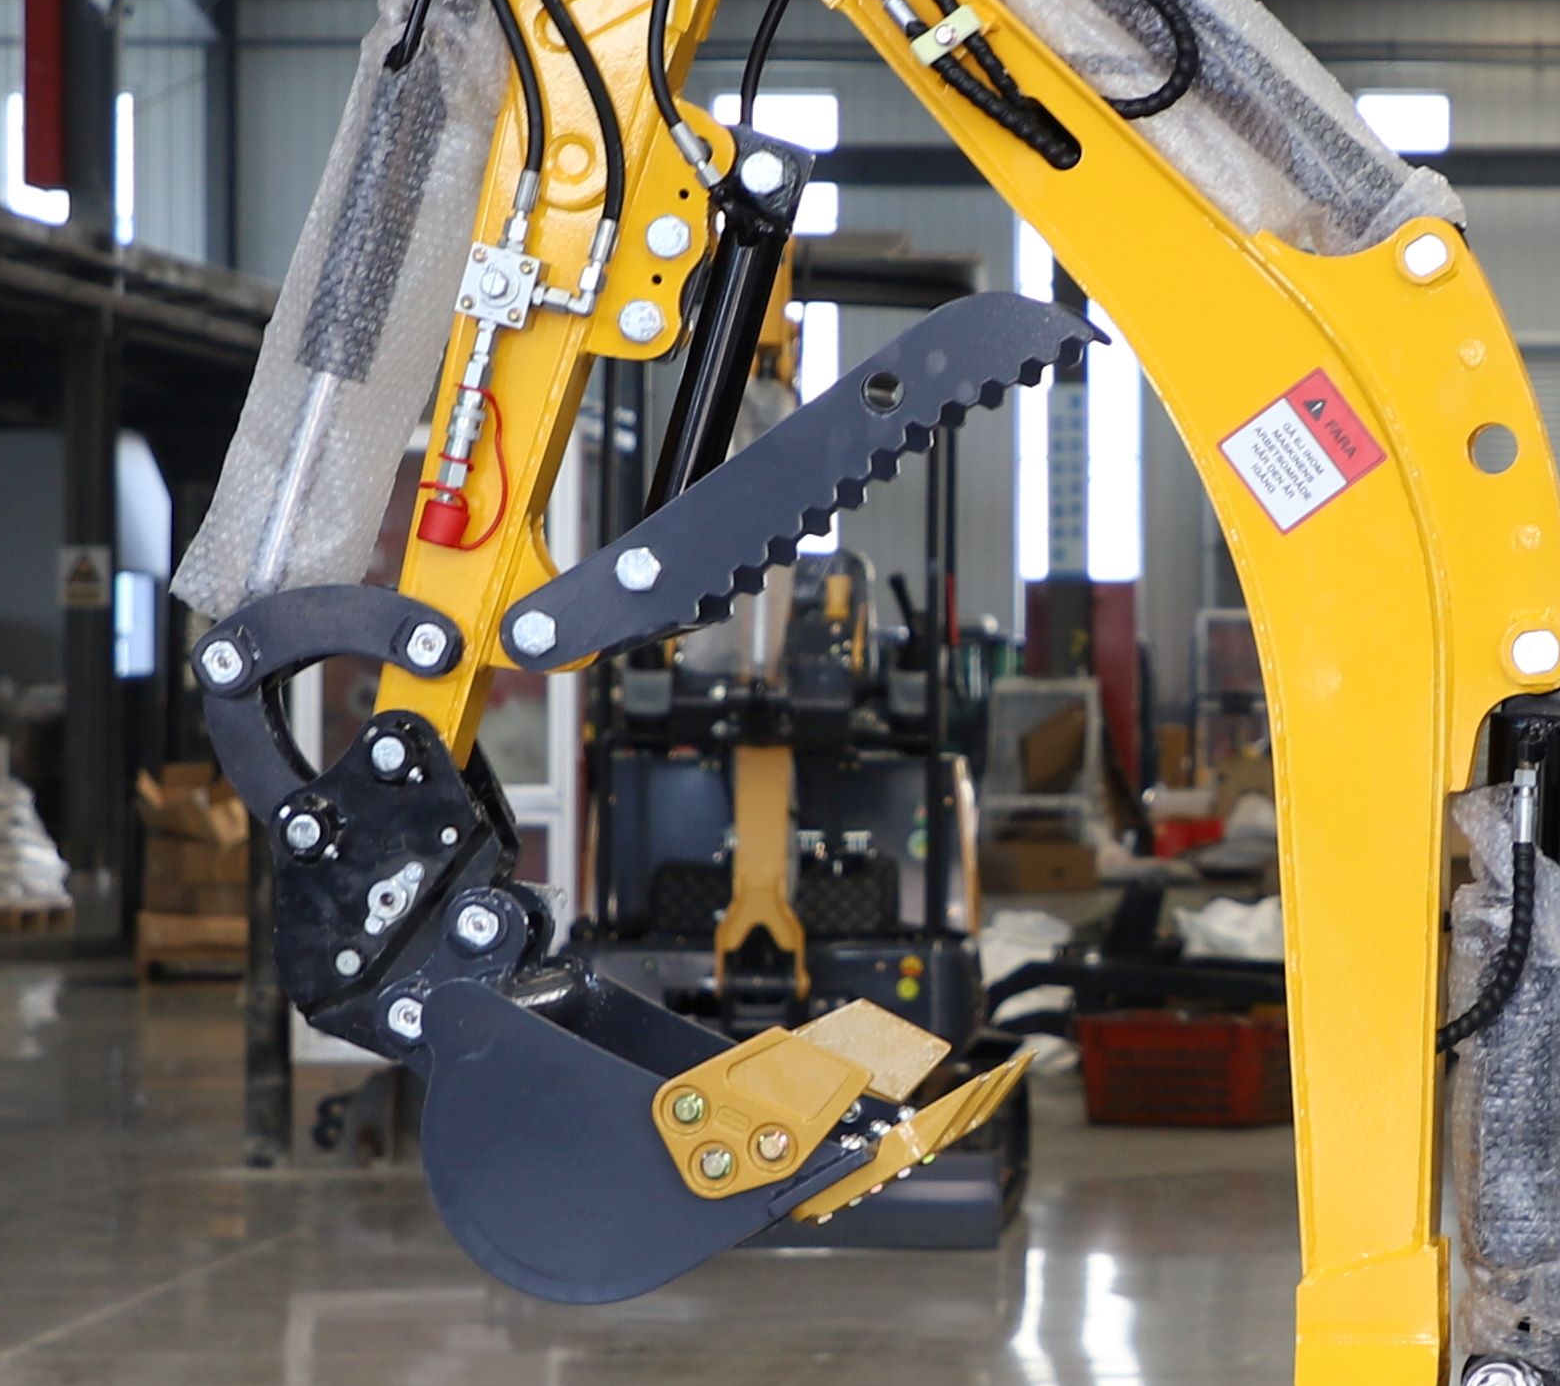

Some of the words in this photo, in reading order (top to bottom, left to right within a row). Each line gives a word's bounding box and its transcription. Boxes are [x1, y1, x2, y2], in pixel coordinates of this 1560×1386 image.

[1324, 419, 1357, 459] FARA
[1272, 429, 1314, 483] MASKINENS
[1303, 449, 1324, 476] INOM
[1267, 463, 1285, 485] DEN
